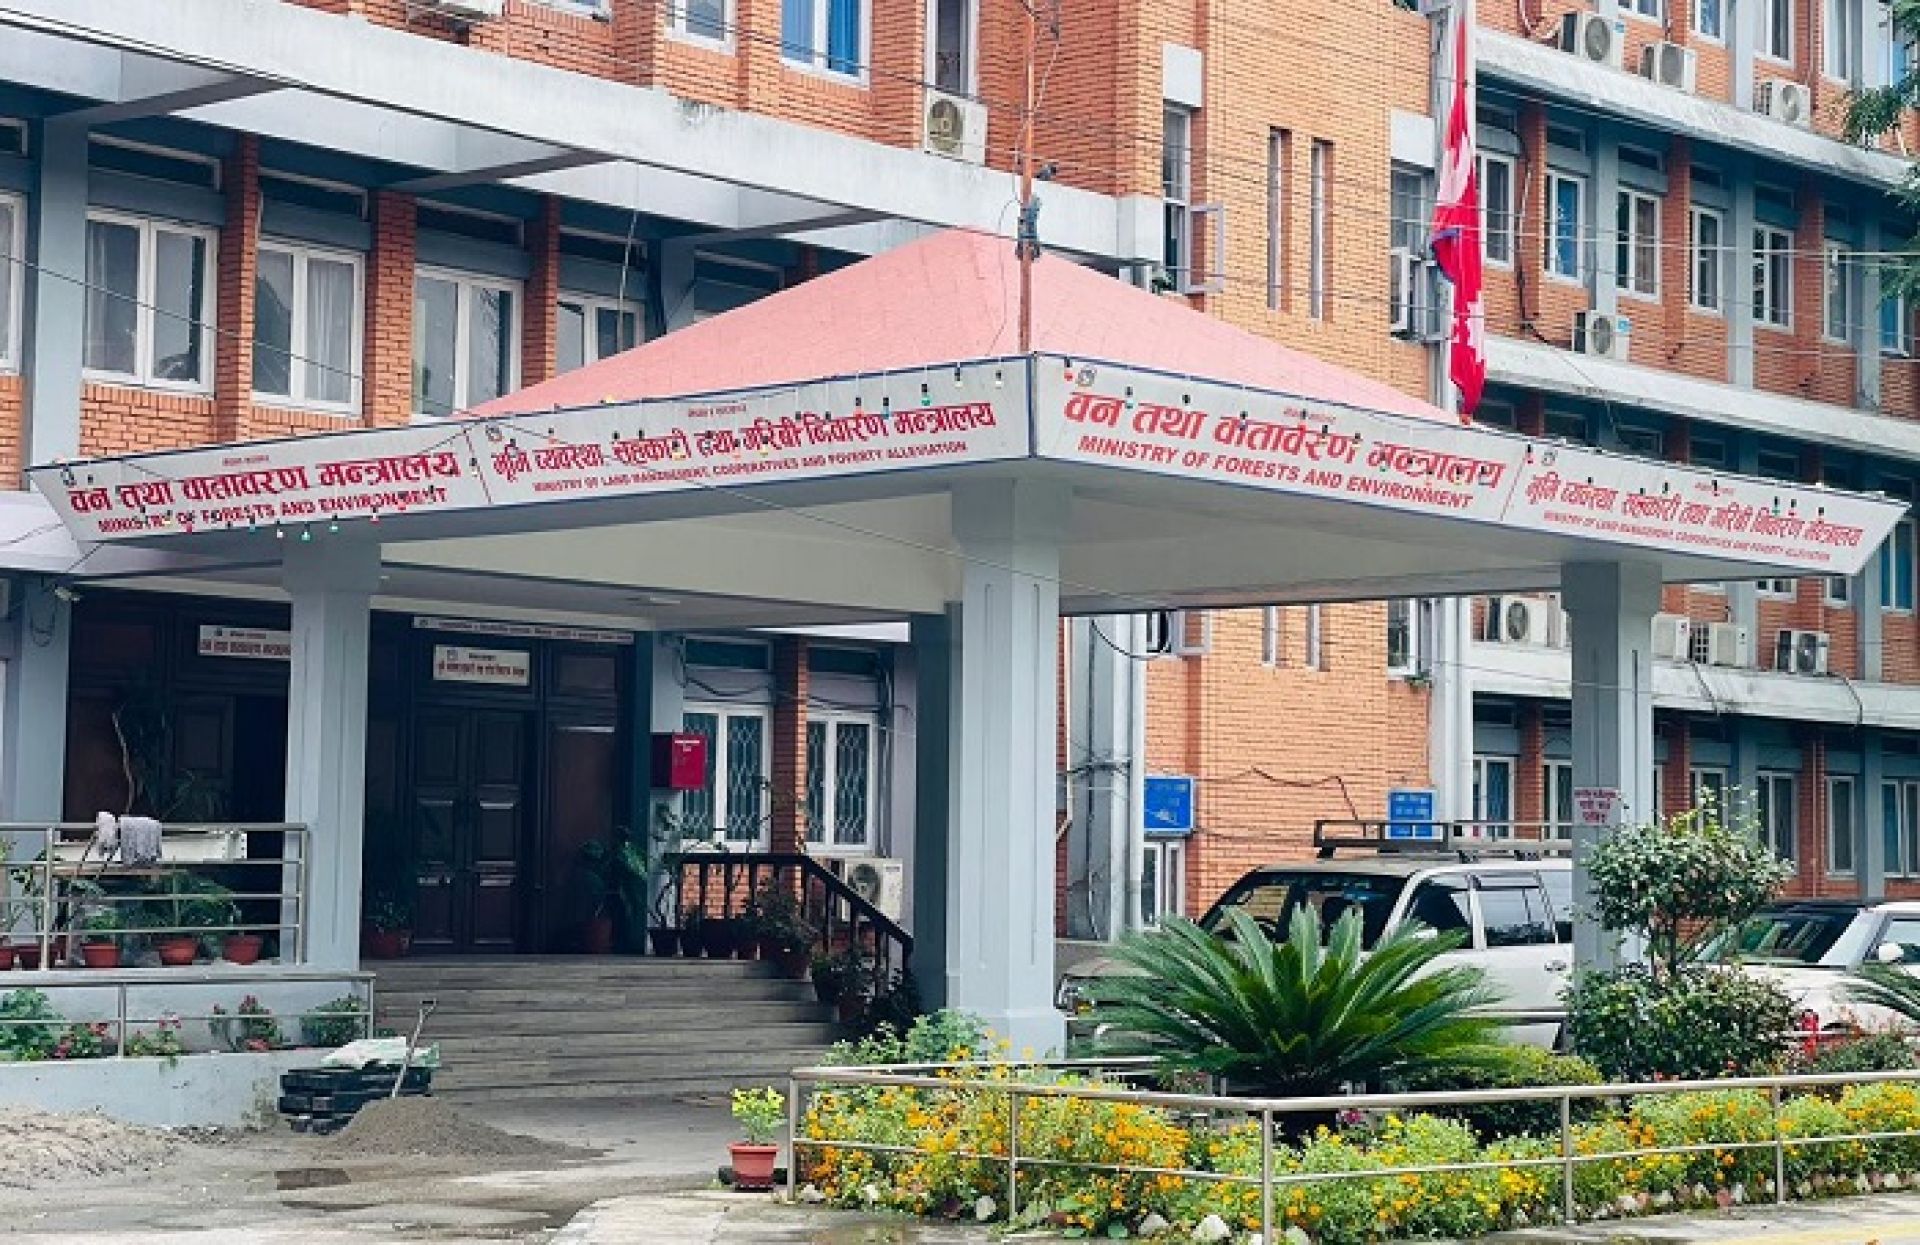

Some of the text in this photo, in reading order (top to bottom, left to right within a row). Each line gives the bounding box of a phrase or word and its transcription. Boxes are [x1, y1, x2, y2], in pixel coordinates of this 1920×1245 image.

[892, 403, 996, 433] मन्त्रालय
[1064, 392, 1125, 427] वन
[1132, 402, 1208, 439] तथा
[1213, 416, 1361, 463] वातावरण
[68, 452, 461, 513] वन तथा वातावरण मन्त्रालय
[1078, 435, 1473, 508] MINISTRY OF FORESTS AND ENVIRONMENT
